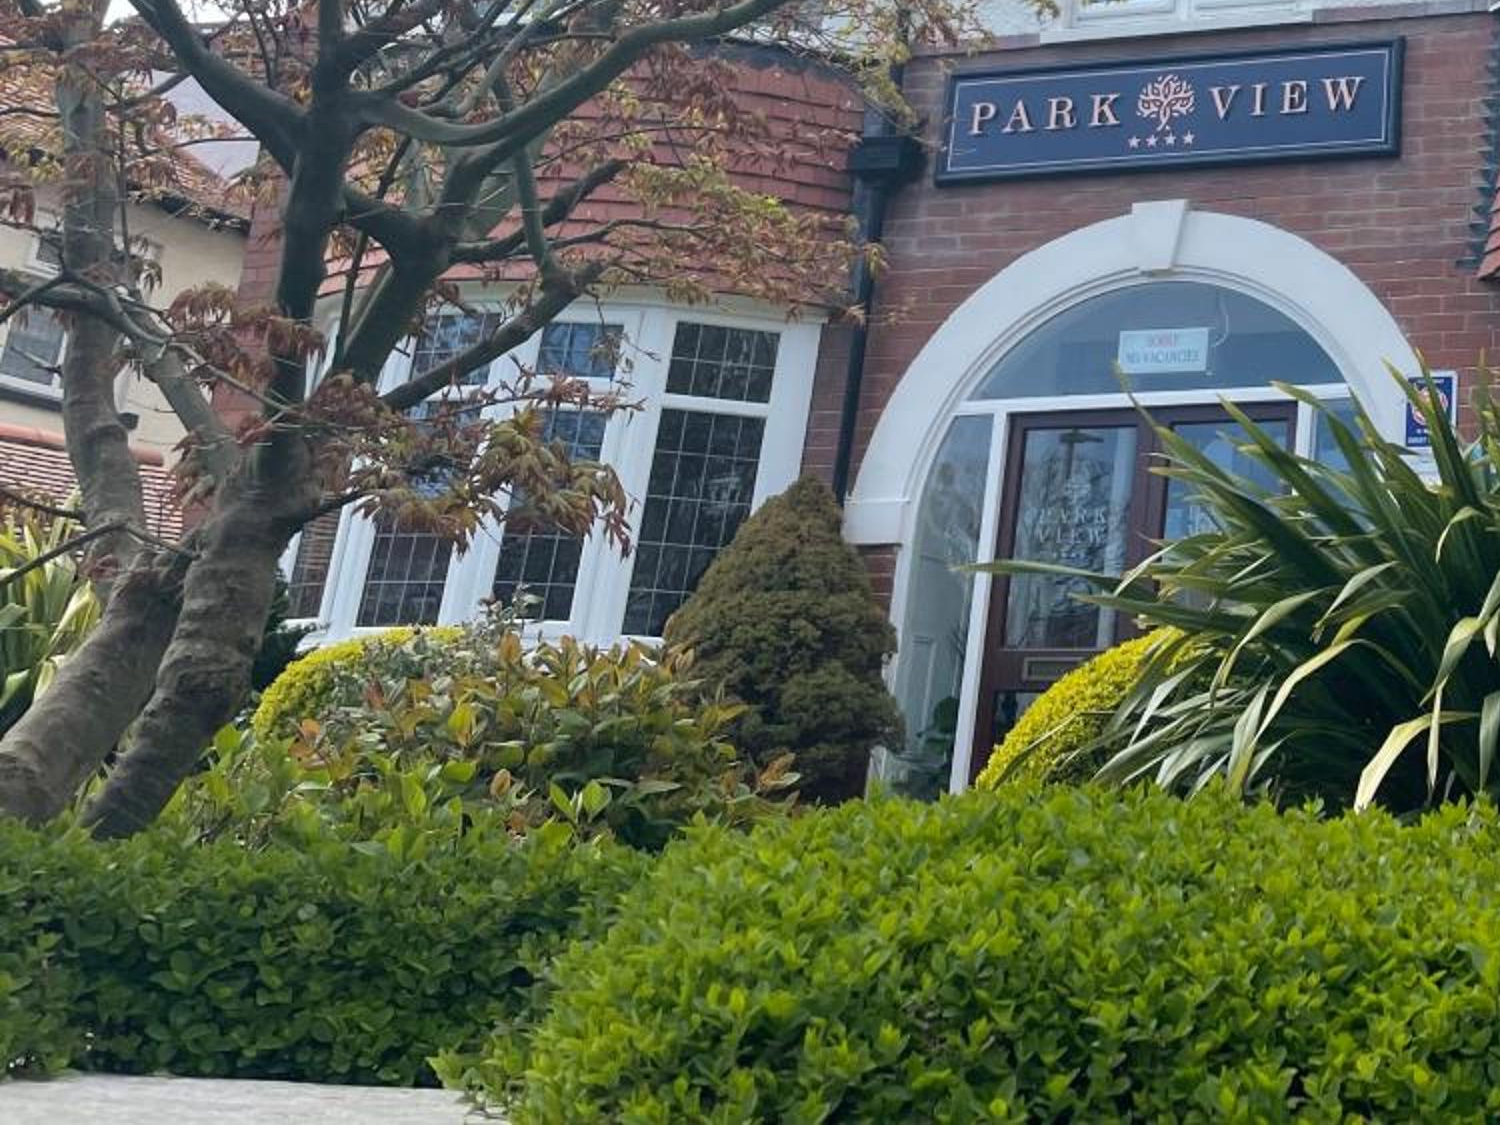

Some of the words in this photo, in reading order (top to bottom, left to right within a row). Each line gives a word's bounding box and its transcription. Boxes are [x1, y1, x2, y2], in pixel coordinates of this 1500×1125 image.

[968, 93, 1121, 135] PARK
[1209, 76, 1365, 120] VIEW
[1039, 507, 1107, 524] PARK
[1038, 526, 1107, 544] VIEW
